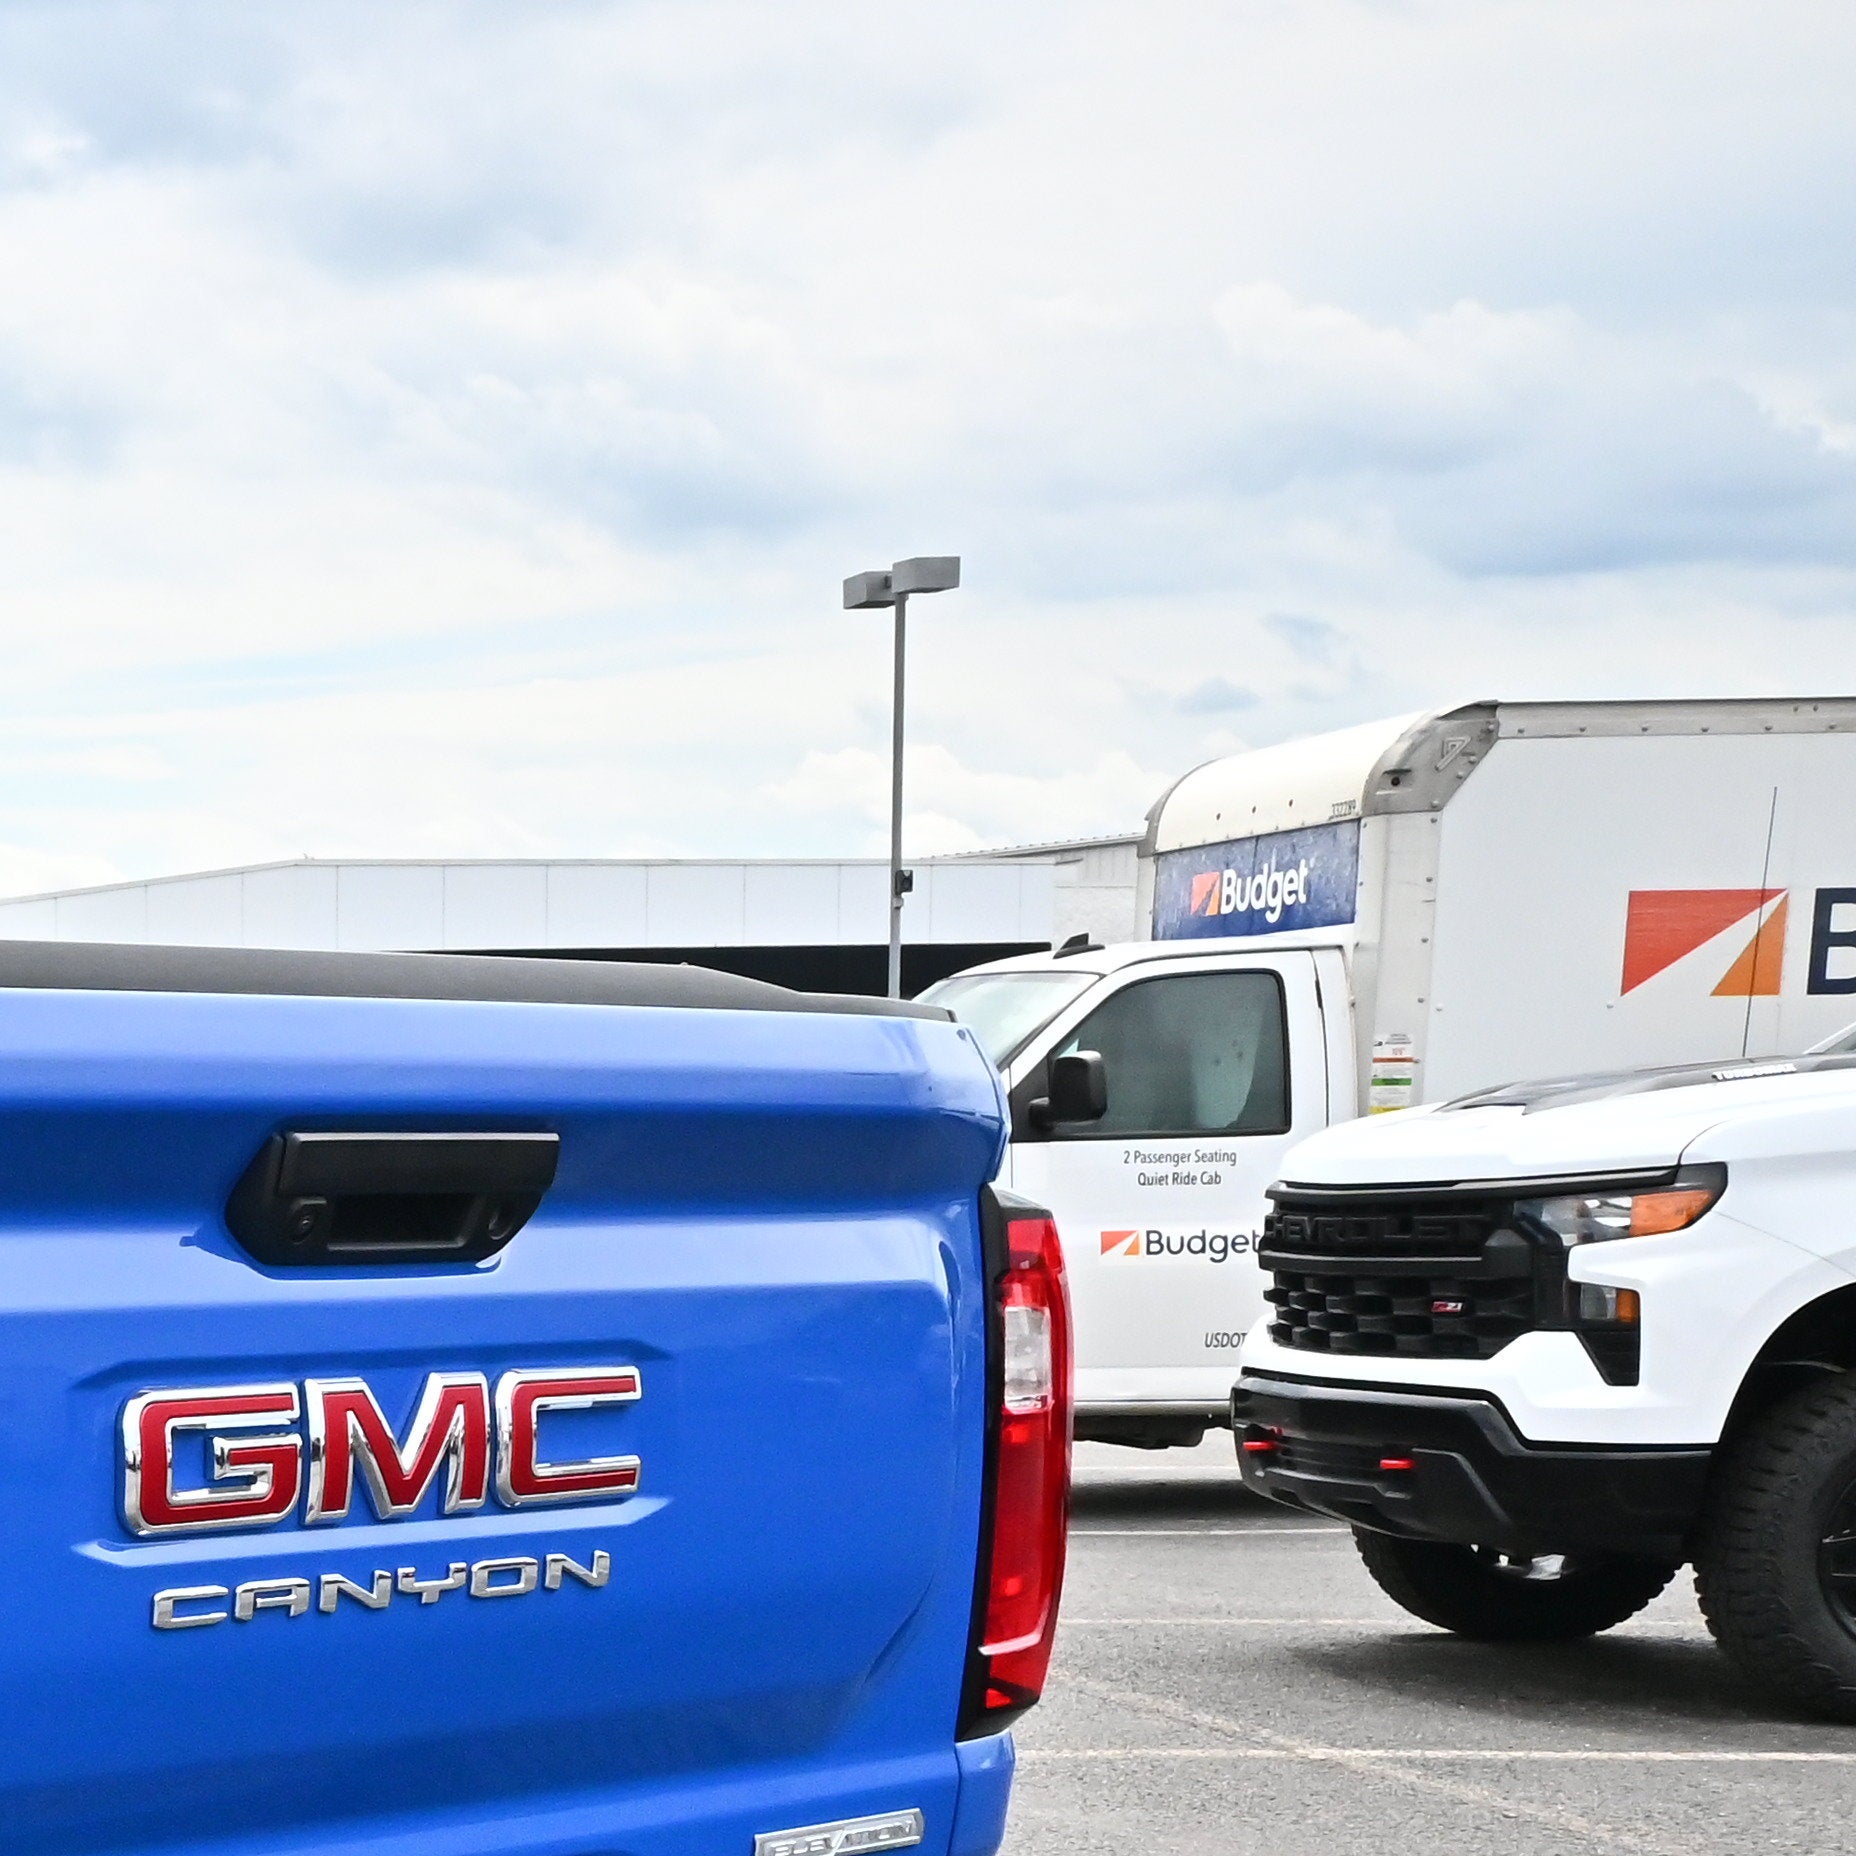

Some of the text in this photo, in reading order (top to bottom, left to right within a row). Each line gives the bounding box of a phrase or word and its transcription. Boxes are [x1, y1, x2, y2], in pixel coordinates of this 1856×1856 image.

[1220, 859, 1309, 923] Budget
[1124, 1149, 1237, 1167] 2 Passenger Seating
[1138, 1171, 1222, 1187] Quiet Ride Cab
[1145, 1229, 1261, 1263] Budget
[122, 1366, 642, 1536] GMC
[151, 1549, 611, 1630] CANYON
